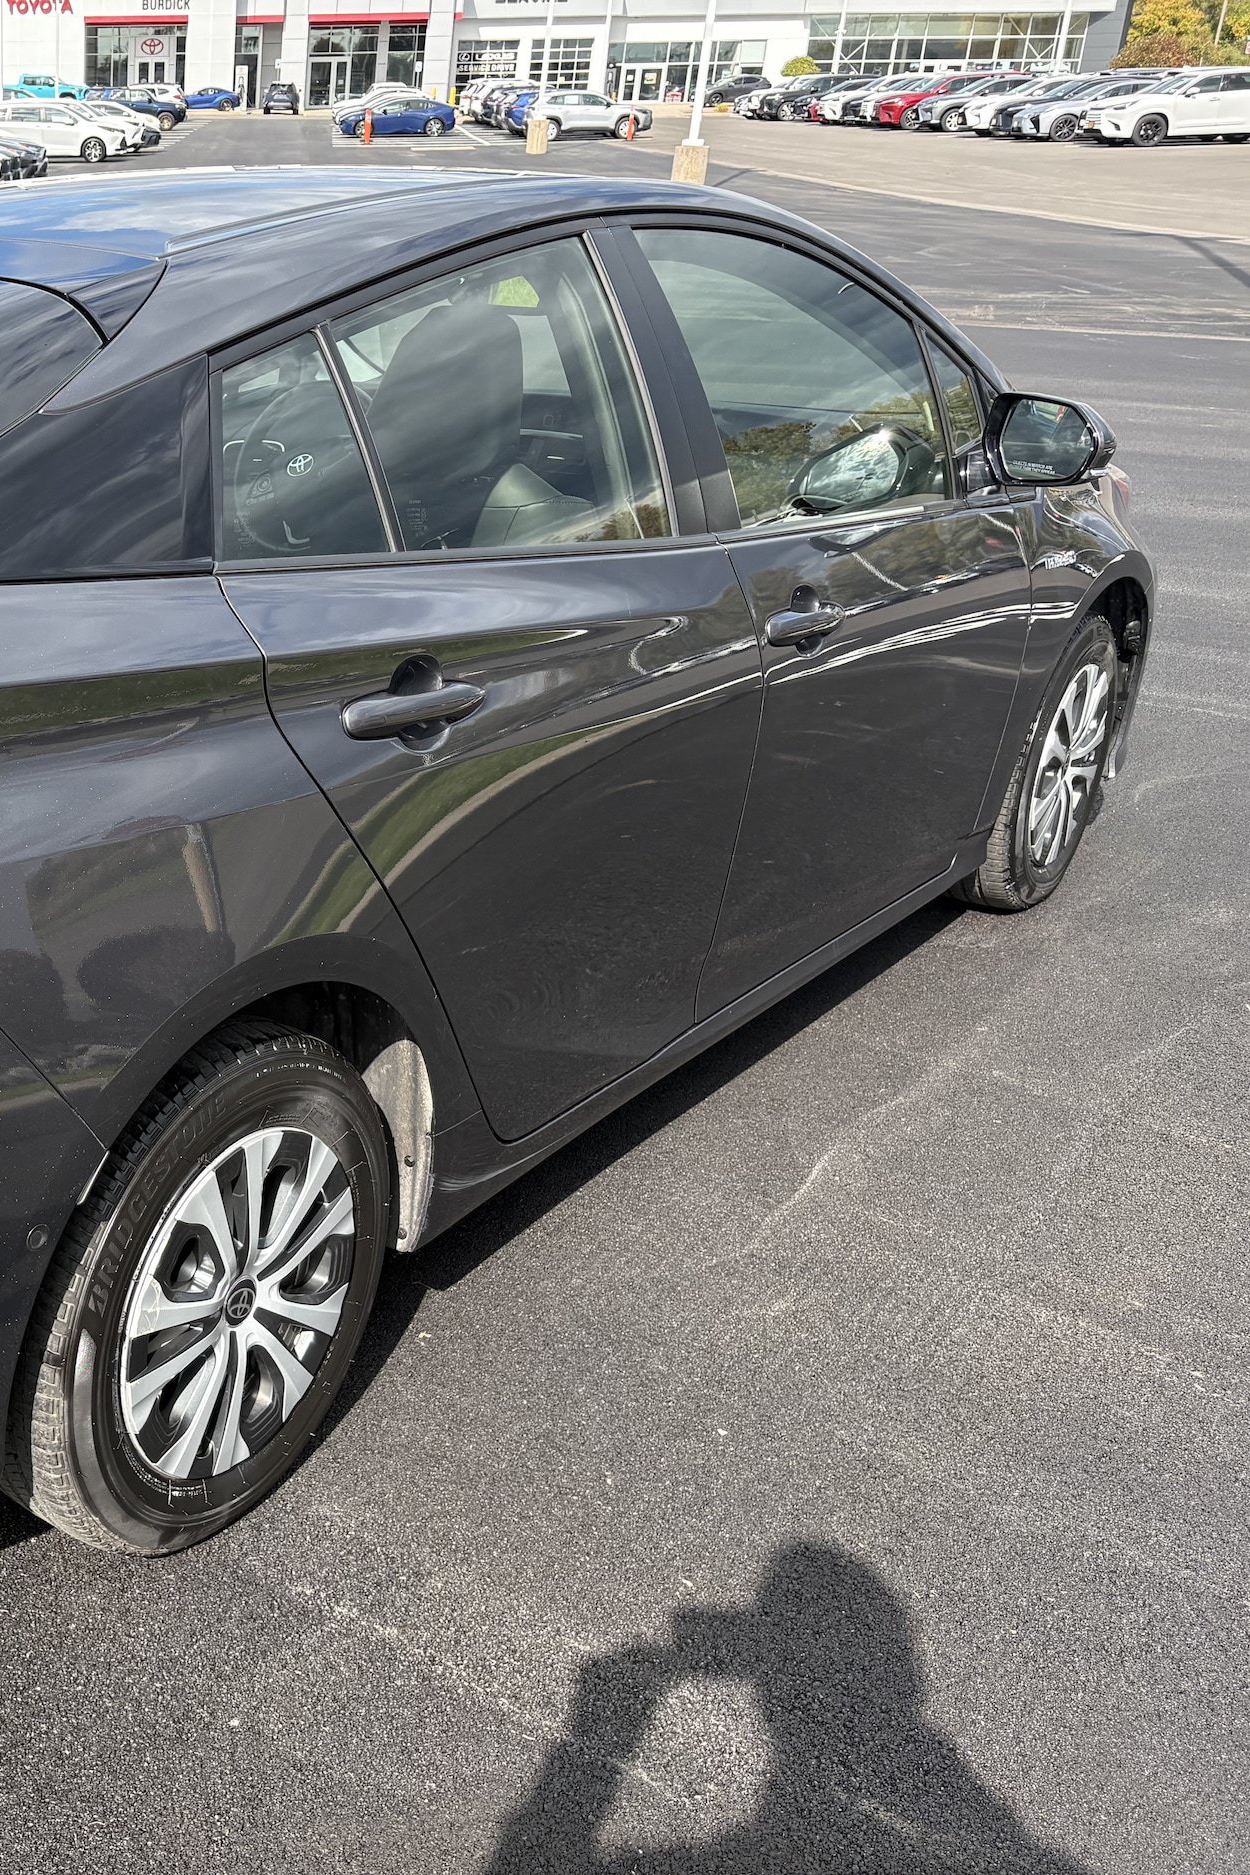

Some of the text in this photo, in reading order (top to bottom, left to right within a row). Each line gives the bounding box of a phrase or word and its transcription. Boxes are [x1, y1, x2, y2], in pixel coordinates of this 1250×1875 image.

[6, 0, 74, 15] TOYOTA
[142, 0, 190, 10] BURDICK
[88, 1092, 227, 1317] BRIDGESTONE
